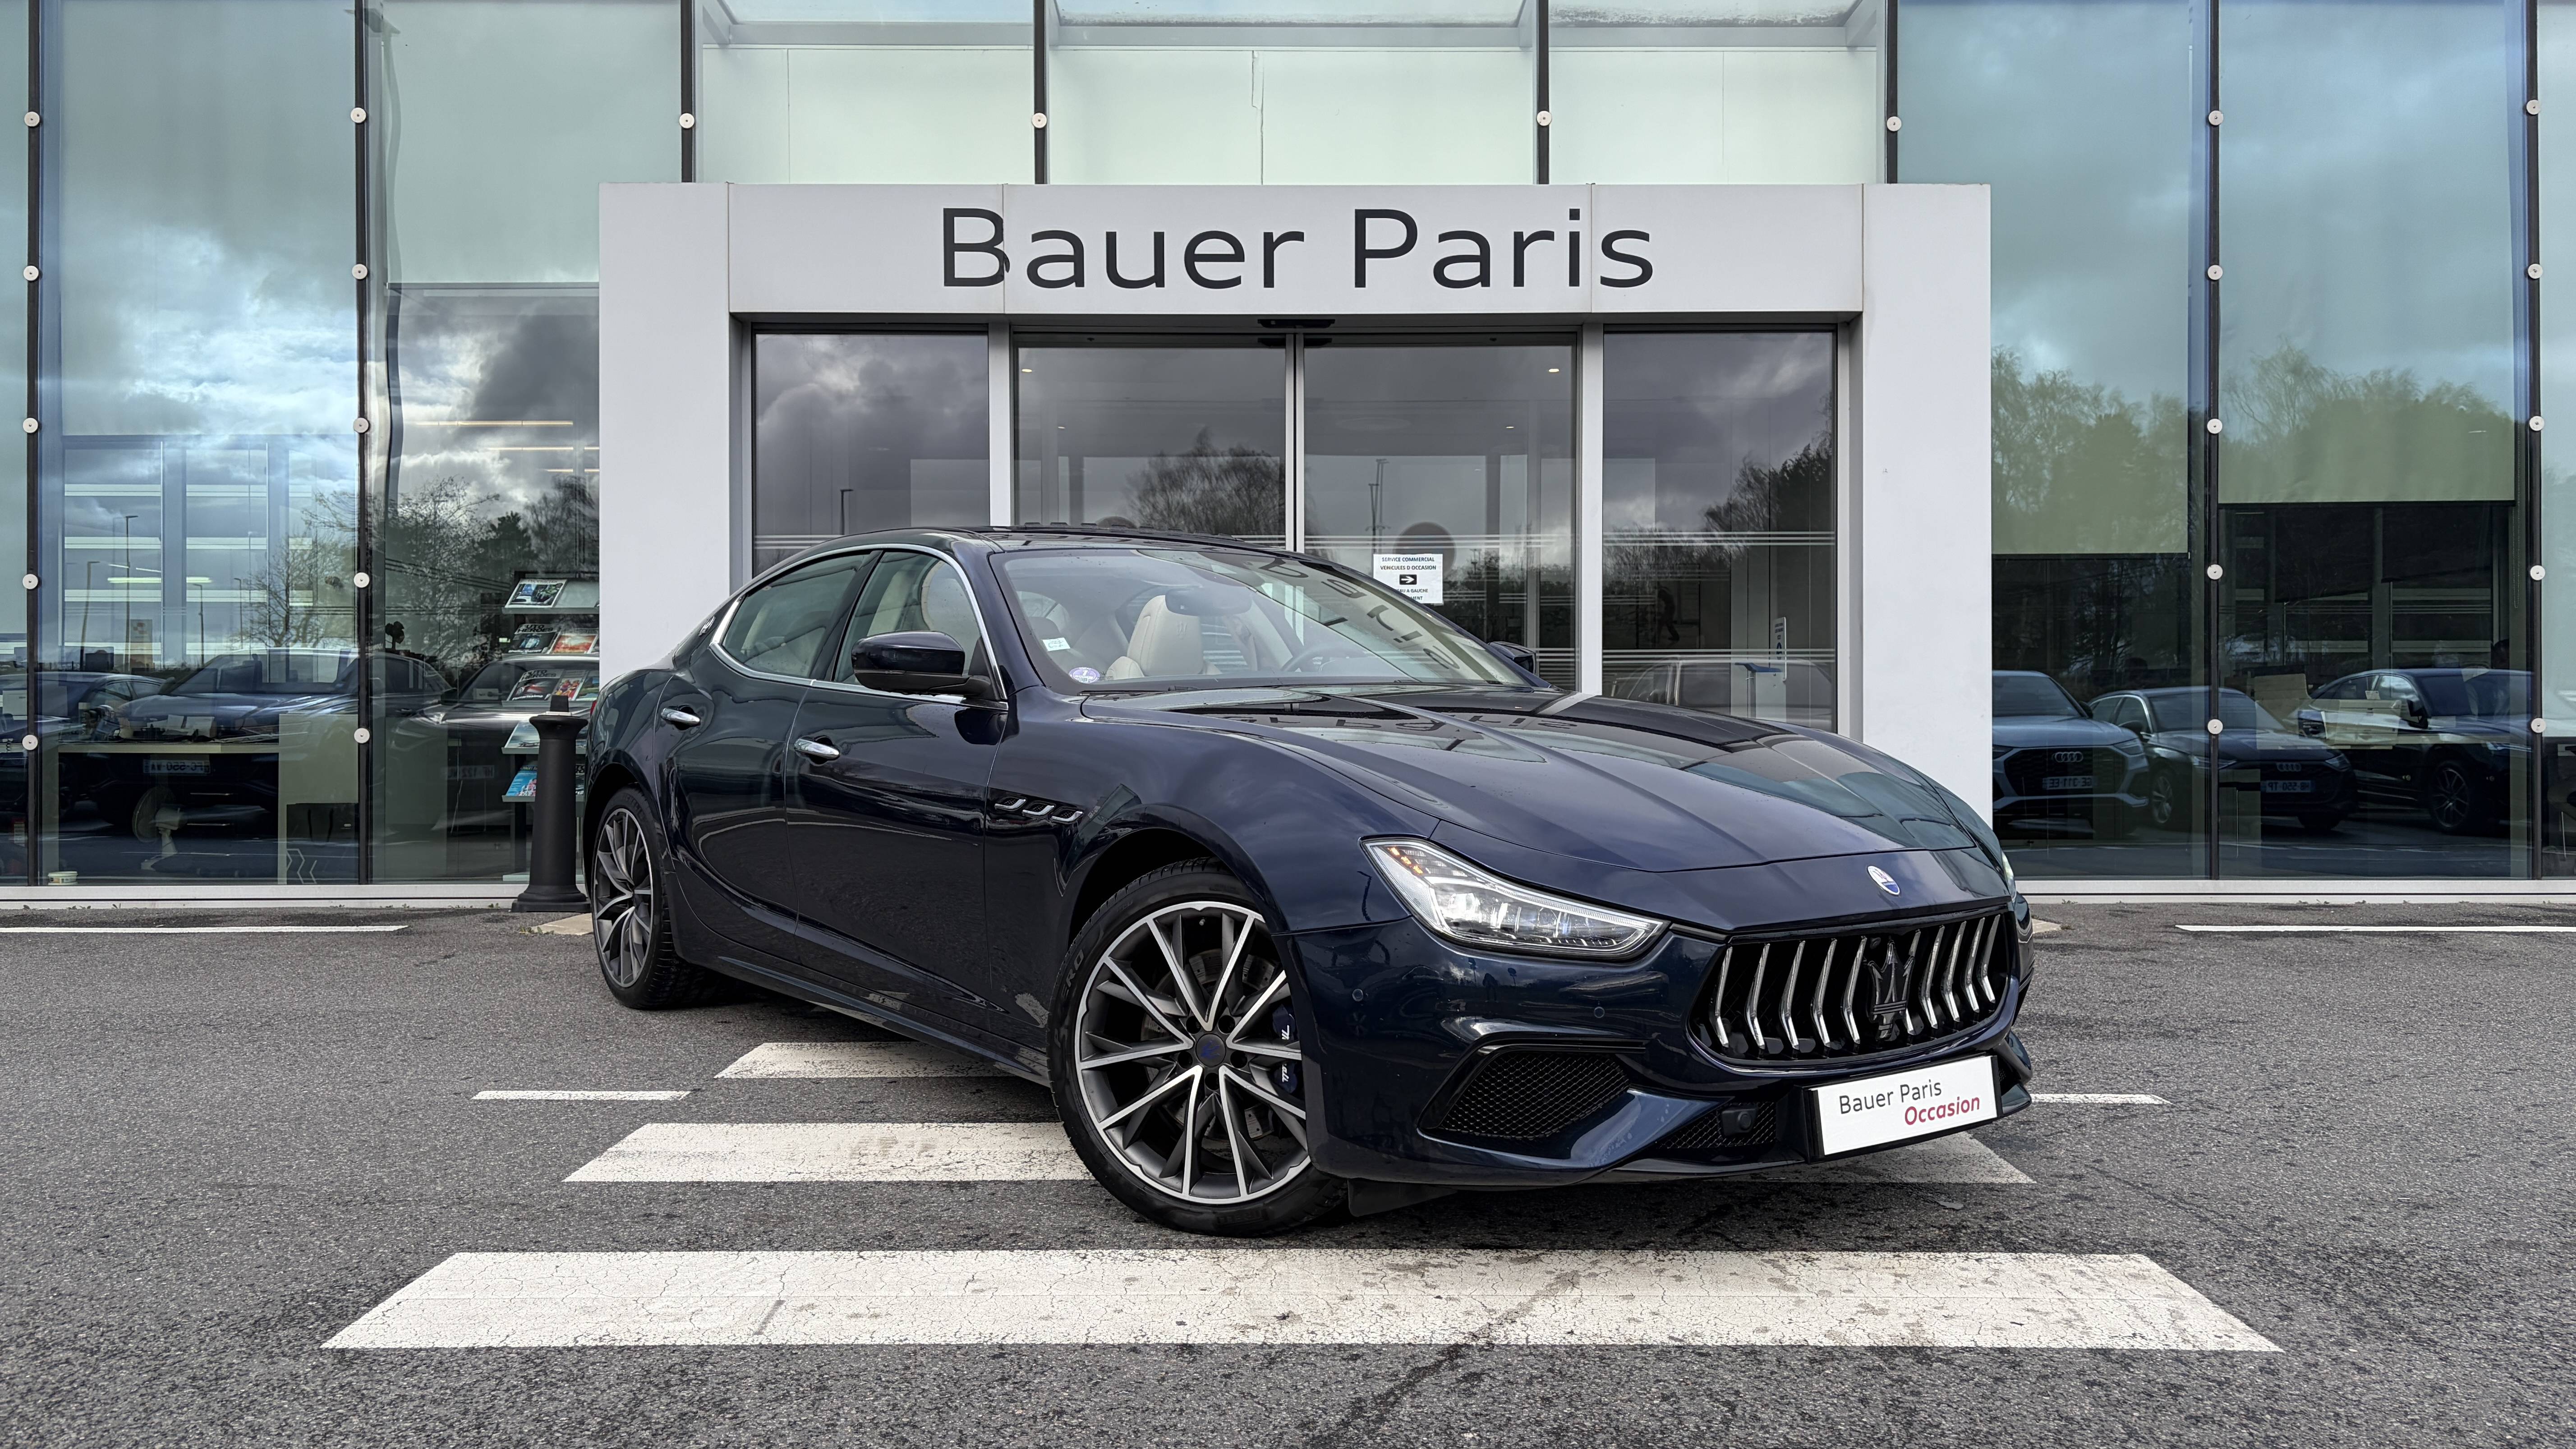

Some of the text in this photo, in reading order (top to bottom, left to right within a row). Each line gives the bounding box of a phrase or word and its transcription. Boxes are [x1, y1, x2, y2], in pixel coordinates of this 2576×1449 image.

[943, 208, 1653, 289] Bauer Paris
[1839, 1079, 1942, 1114] Bauer Paris
[1904, 1096, 1980, 1125] Occasion
